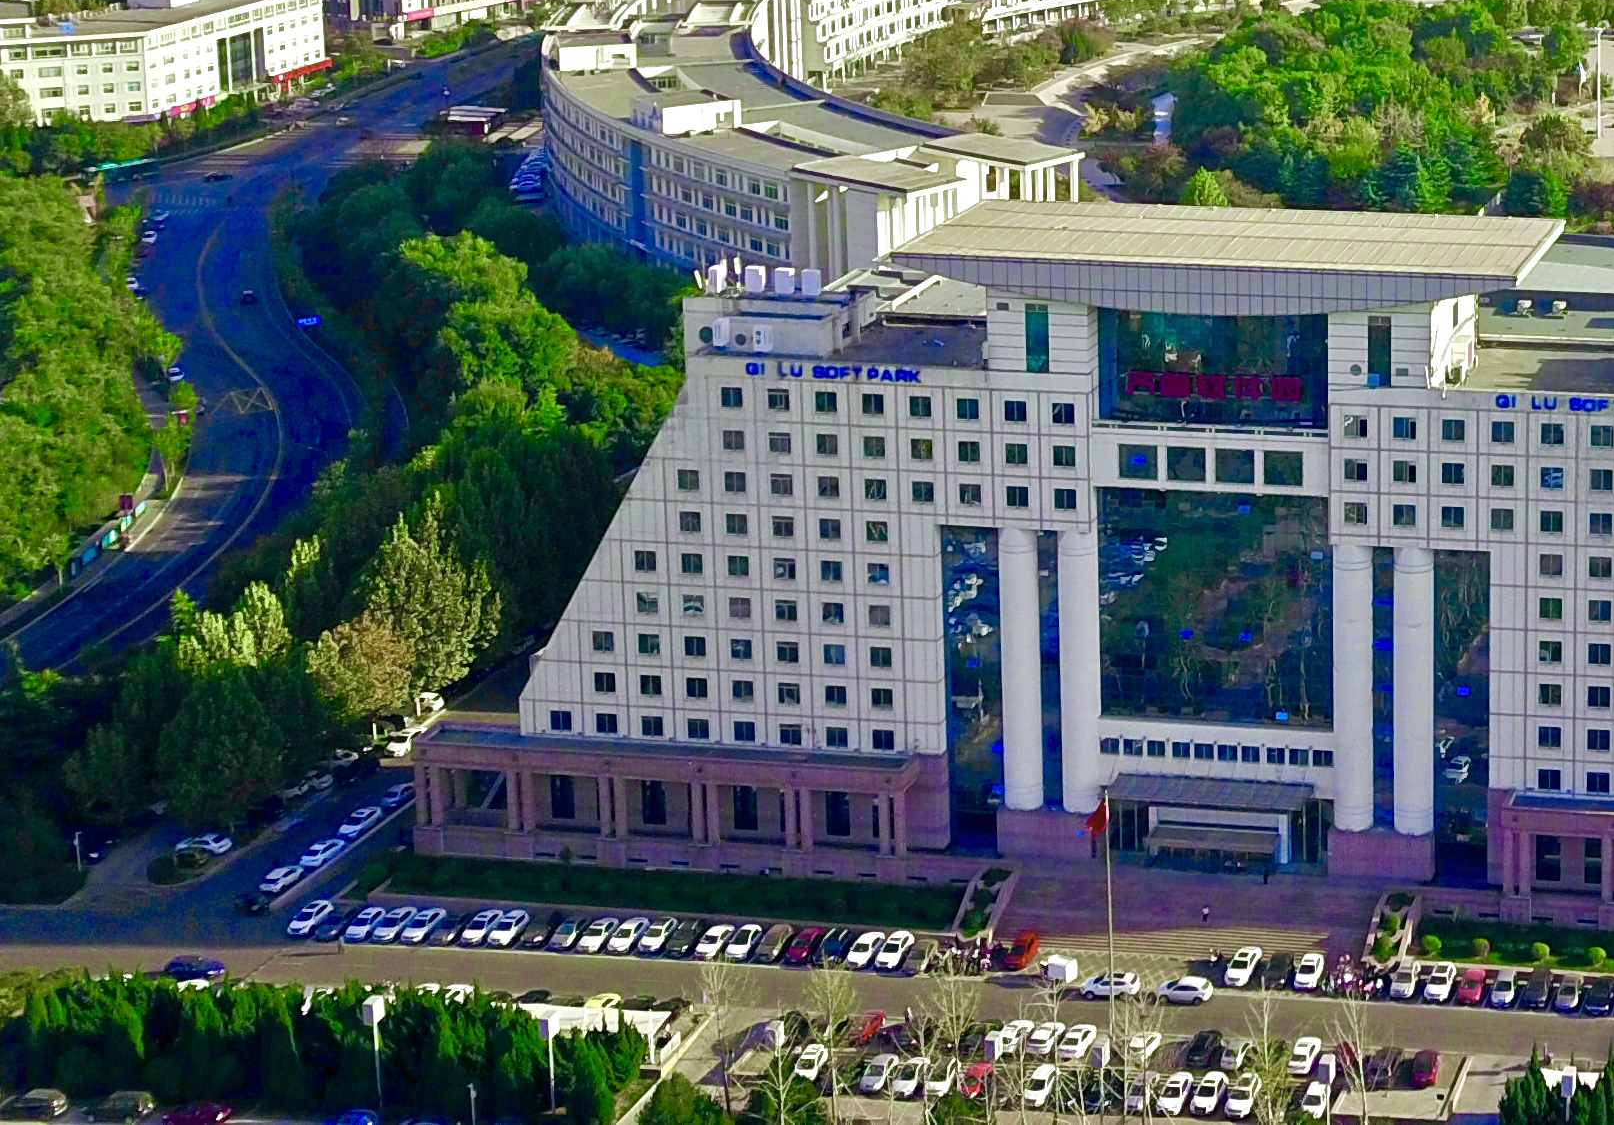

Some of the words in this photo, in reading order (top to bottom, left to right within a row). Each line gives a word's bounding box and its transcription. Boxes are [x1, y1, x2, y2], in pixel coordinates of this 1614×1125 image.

[812, 365, 862, 380] SOFT
[867, 367, 920, 383] PARK
[1531, 395, 1557, 410] LU
